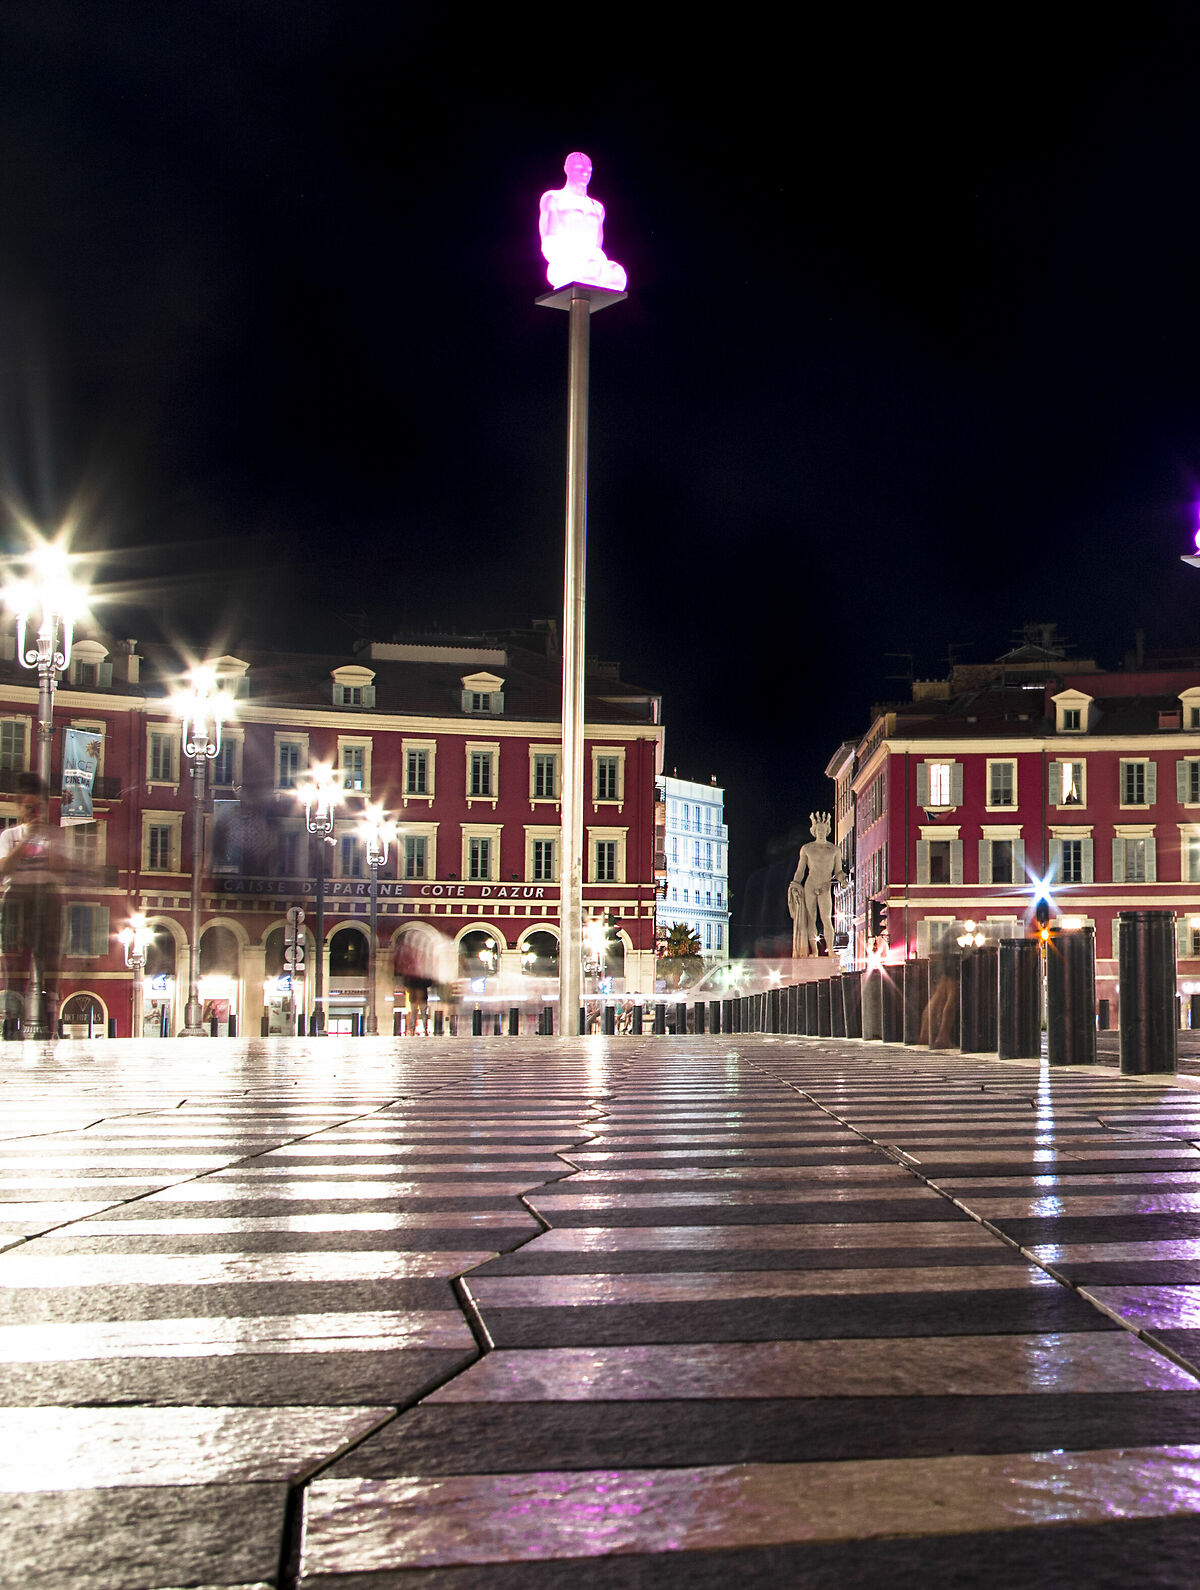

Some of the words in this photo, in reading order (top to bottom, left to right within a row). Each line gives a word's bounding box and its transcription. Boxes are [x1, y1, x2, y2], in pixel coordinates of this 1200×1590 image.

[223, 879, 286, 893] CAISSE
[420, 884, 466, 897] COTE
[481, 886, 545, 898] D'AZUR
